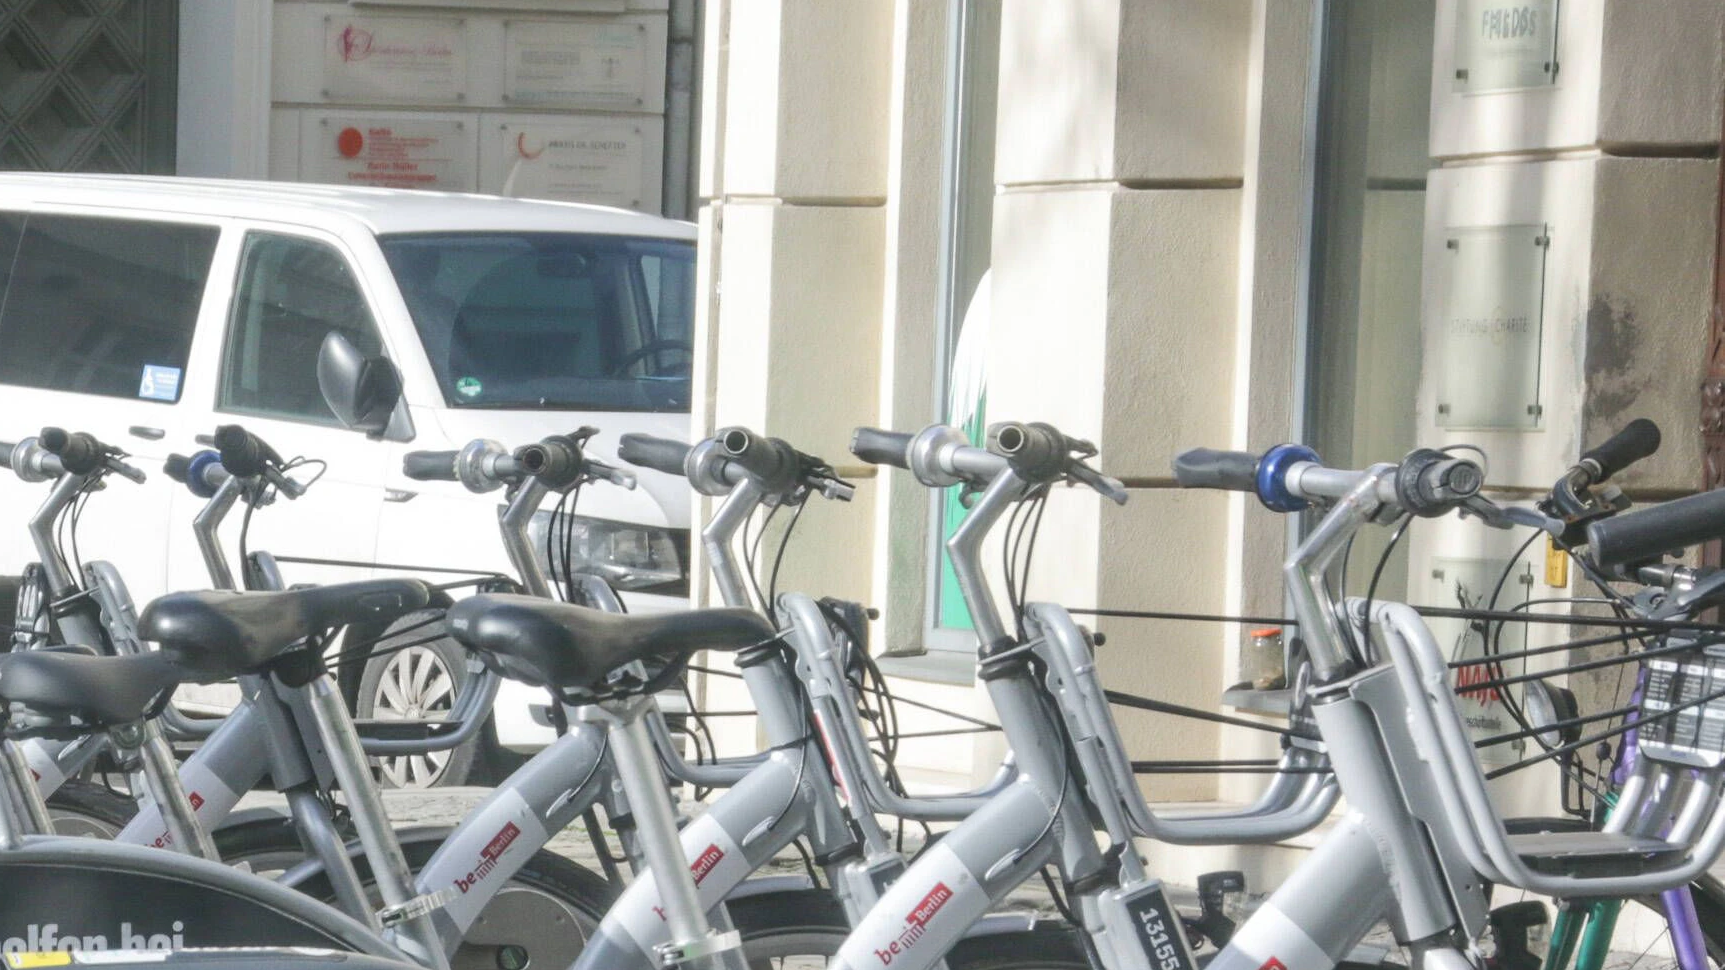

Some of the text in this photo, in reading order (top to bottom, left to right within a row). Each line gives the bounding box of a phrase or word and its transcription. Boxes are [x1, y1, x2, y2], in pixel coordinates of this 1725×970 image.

[453, 826, 518, 894] be Berlin
[874, 888, 949, 967] be Berlin
